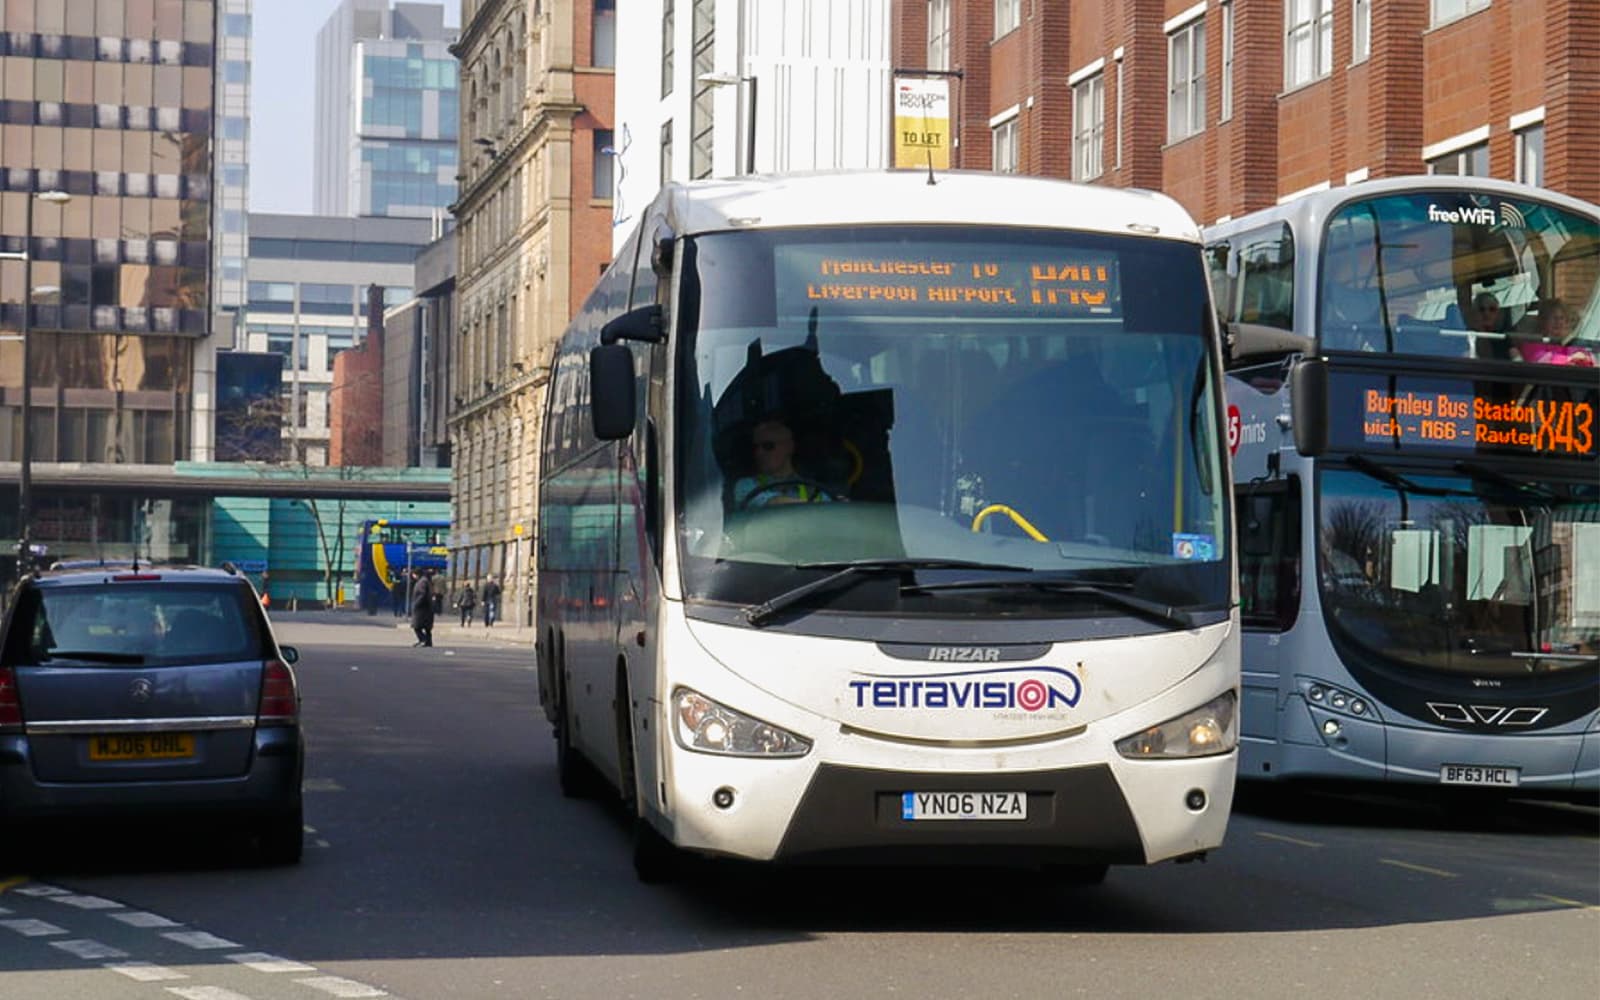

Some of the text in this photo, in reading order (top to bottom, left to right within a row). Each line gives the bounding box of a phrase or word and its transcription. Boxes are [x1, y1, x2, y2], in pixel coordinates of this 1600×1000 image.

[902, 131, 942, 145] TO LET
[1367, 389, 1536, 424] Burnley Bus Station
[1421, 420, 1458, 441] M66
[1536, 399, 1593, 454] X43
[928, 647, 1000, 661] IRIZAR
[1447, 768, 1512, 783] BF63 HCL
[918, 794, 1022, 814] YN06 NZA
